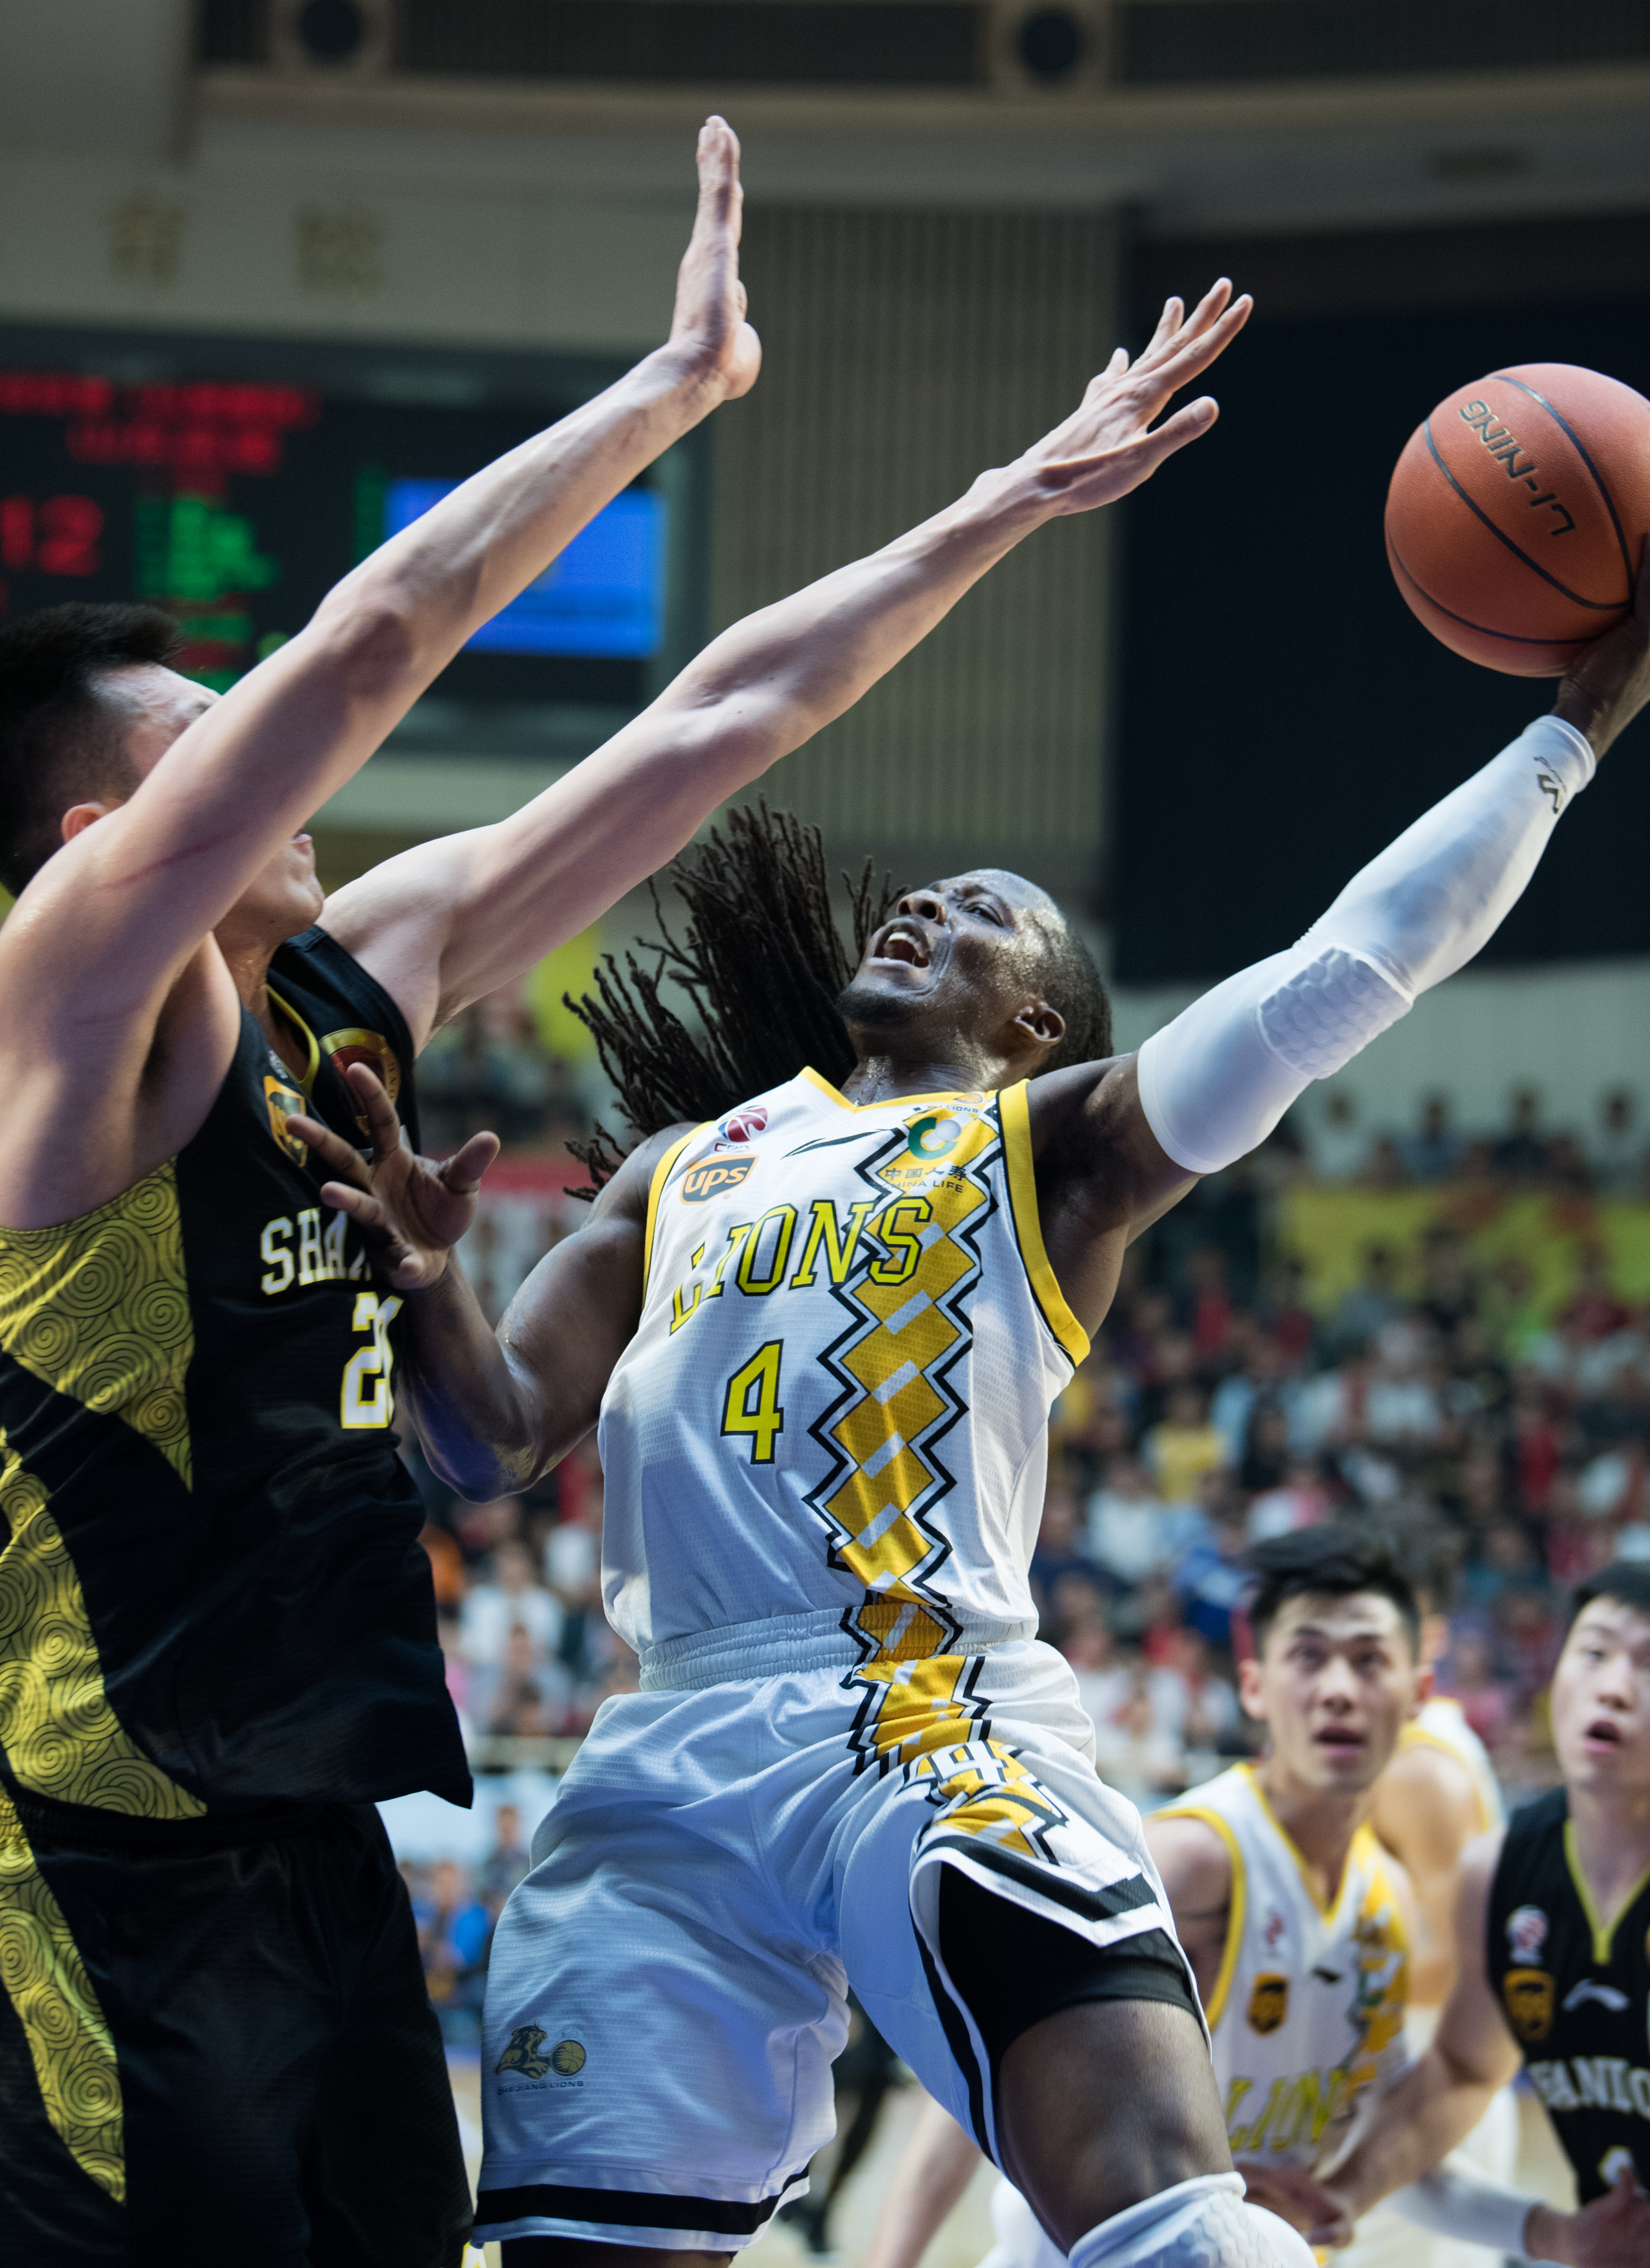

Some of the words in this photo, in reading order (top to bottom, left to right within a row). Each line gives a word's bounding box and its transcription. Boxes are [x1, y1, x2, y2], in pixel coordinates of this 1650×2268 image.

[1458, 399, 1575, 537] LI-NING
[946, 1104, 979, 1114] LIONS
[882, 1180, 927, 1189] CHINA
[933, 1180, 963, 1193] LIFE
[884, 1165, 967, 1181] 中国人寿
[669, 1196, 934, 1337] LIONS
[720, 1338, 784, 1465] 4
